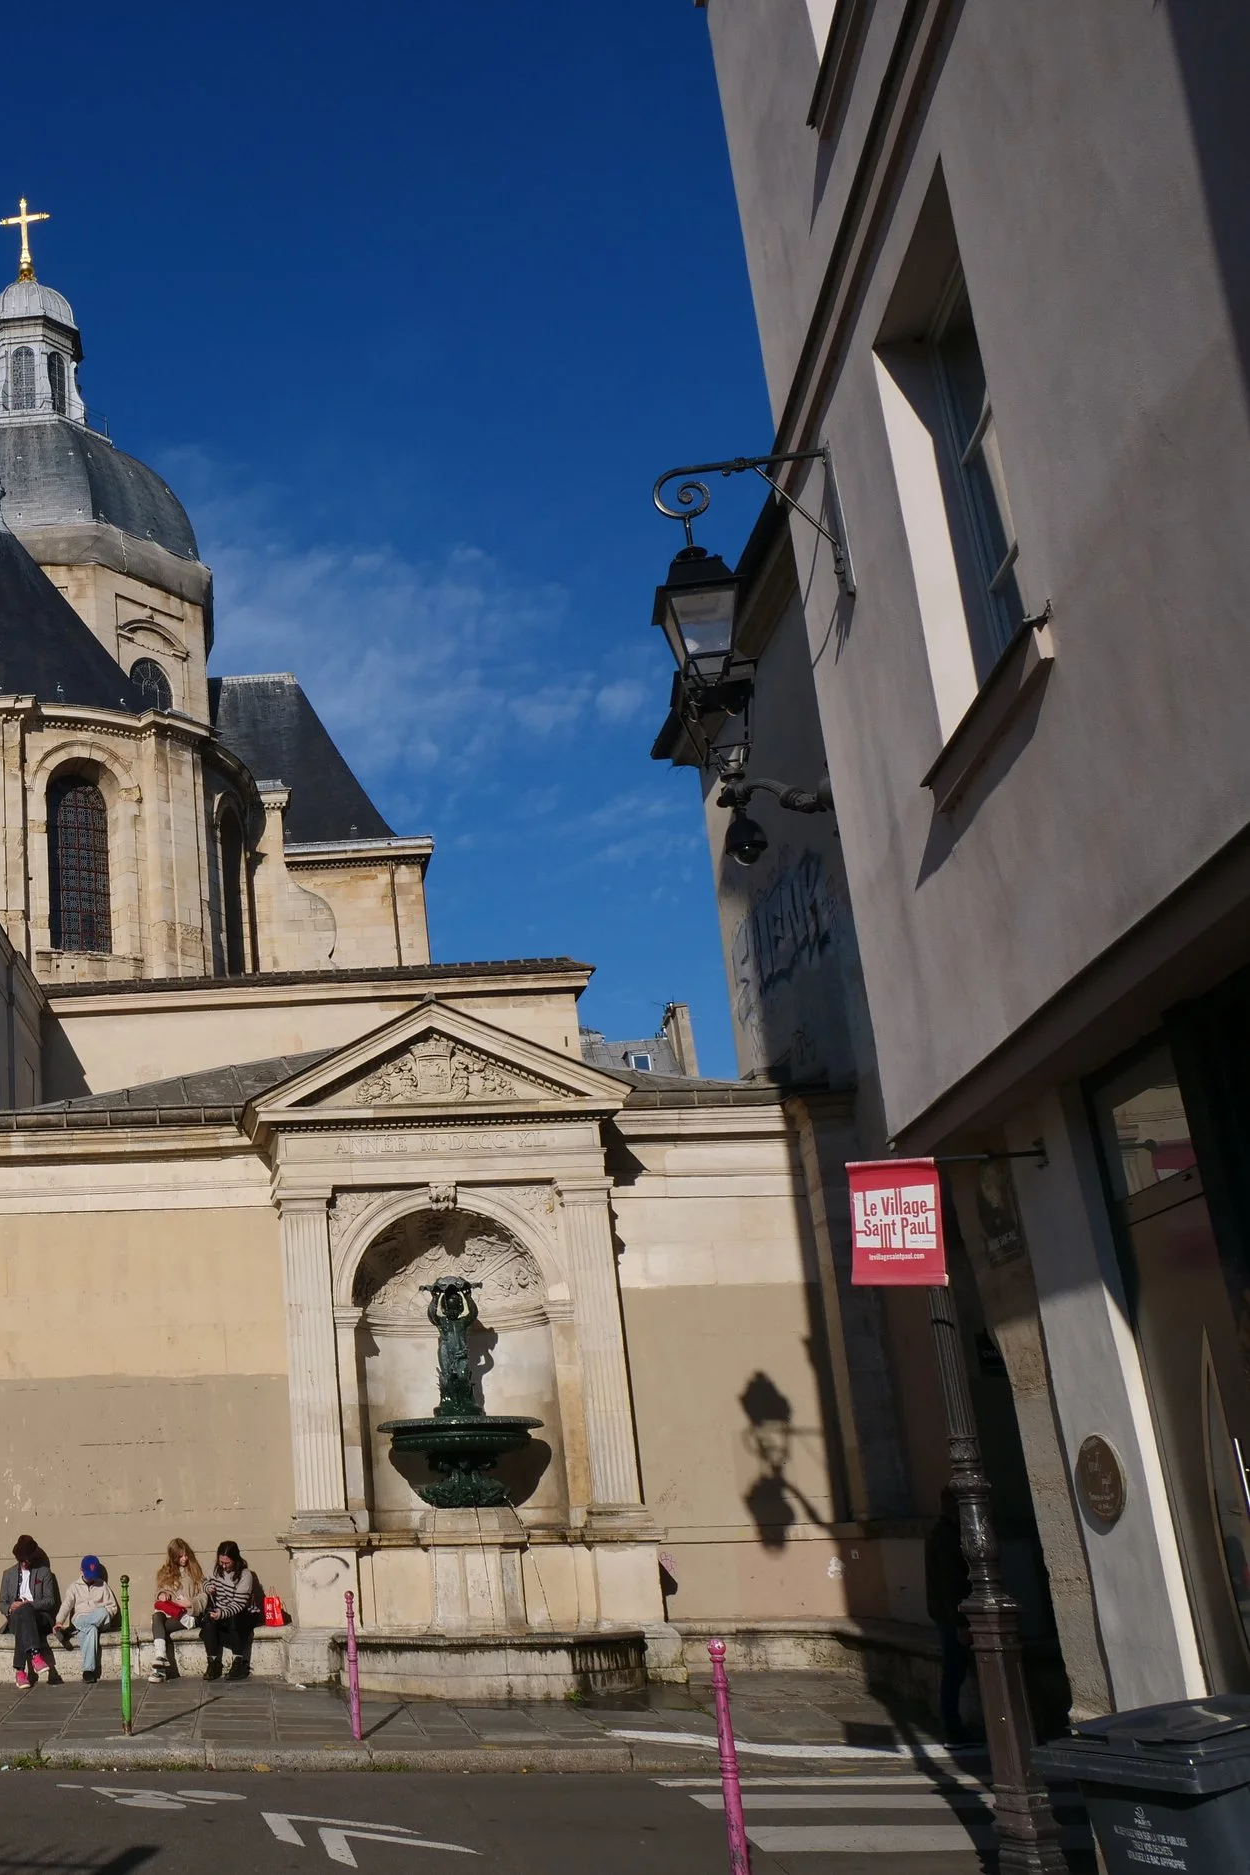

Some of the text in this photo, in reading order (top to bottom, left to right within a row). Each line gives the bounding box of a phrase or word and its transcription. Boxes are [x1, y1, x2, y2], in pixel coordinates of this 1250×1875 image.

[334, 1135, 408, 1154] ANNÉE
[863, 1190, 932, 1217] Le Village
[860, 1219, 897, 1243] Saint
[869, 1253, 925, 1261] levillagesaintpaul.com
